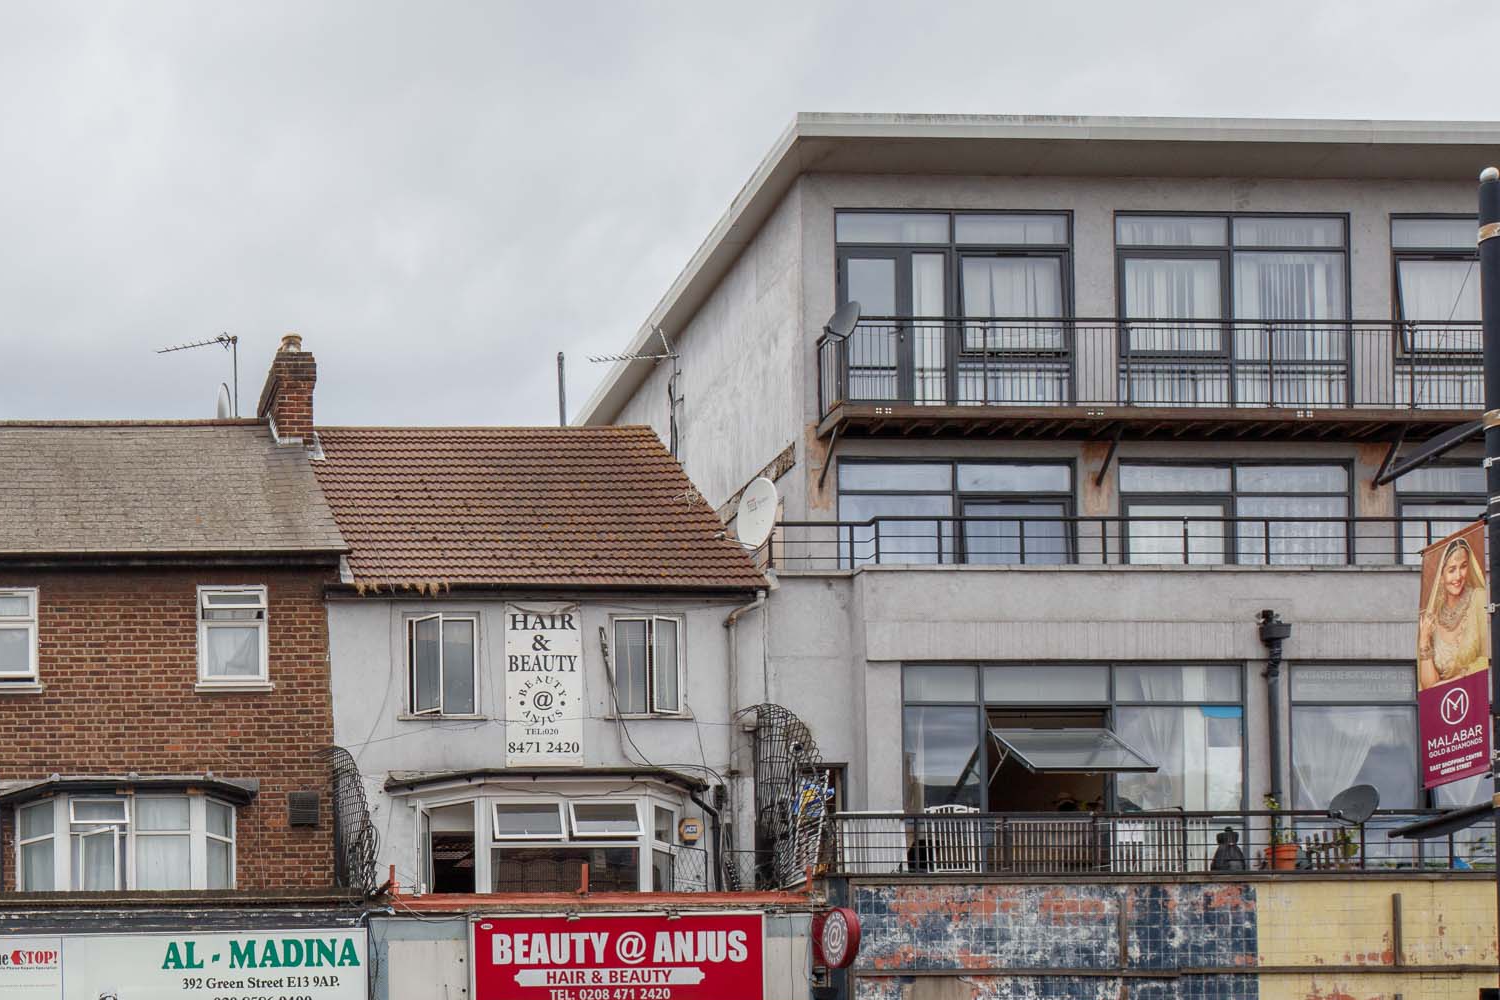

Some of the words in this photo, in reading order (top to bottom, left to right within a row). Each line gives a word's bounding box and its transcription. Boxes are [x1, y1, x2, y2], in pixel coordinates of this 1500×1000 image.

[508, 613, 577, 631] HAIR
[531, 634, 551, 651] &
[508, 655, 578, 672] BEAUTY
[518, 675, 567, 697] BEAUTY
[533, 691, 553, 710] @
[522, 710, 563, 726] ANJUS
[1427, 724, 1483, 751] MALABAR
[508, 742, 541, 753] 8471
[546, 742, 580, 753] 2420
[1428, 748, 1446, 758] GOLD
[1451, 737, 1483, 752] DIAMONDS
[161, 941, 204, 969] AL
[229, 938, 361, 968] MADINA
[492, 932, 609, 965] BEAUTY
[615, 932, 647, 965] @
[652, 930, 748, 963] ANJUS
[182, 978, 202, 989] 392
[206, 977, 244, 989] Green
[248, 977, 284, 988] Street
[287, 976, 309, 988] E13
[313, 975, 340, 987] 9AP.
[546, 970, 589, 985] HAIR
[591, 970, 603, 984] &
[609, 969, 672, 983] BEAUTY
[550, 989, 575, 1000] TEL:
[579, 989, 610, 1000] 0208
[614, 989, 635, 1000] 471
[640, 988, 671, 1000] 2420
